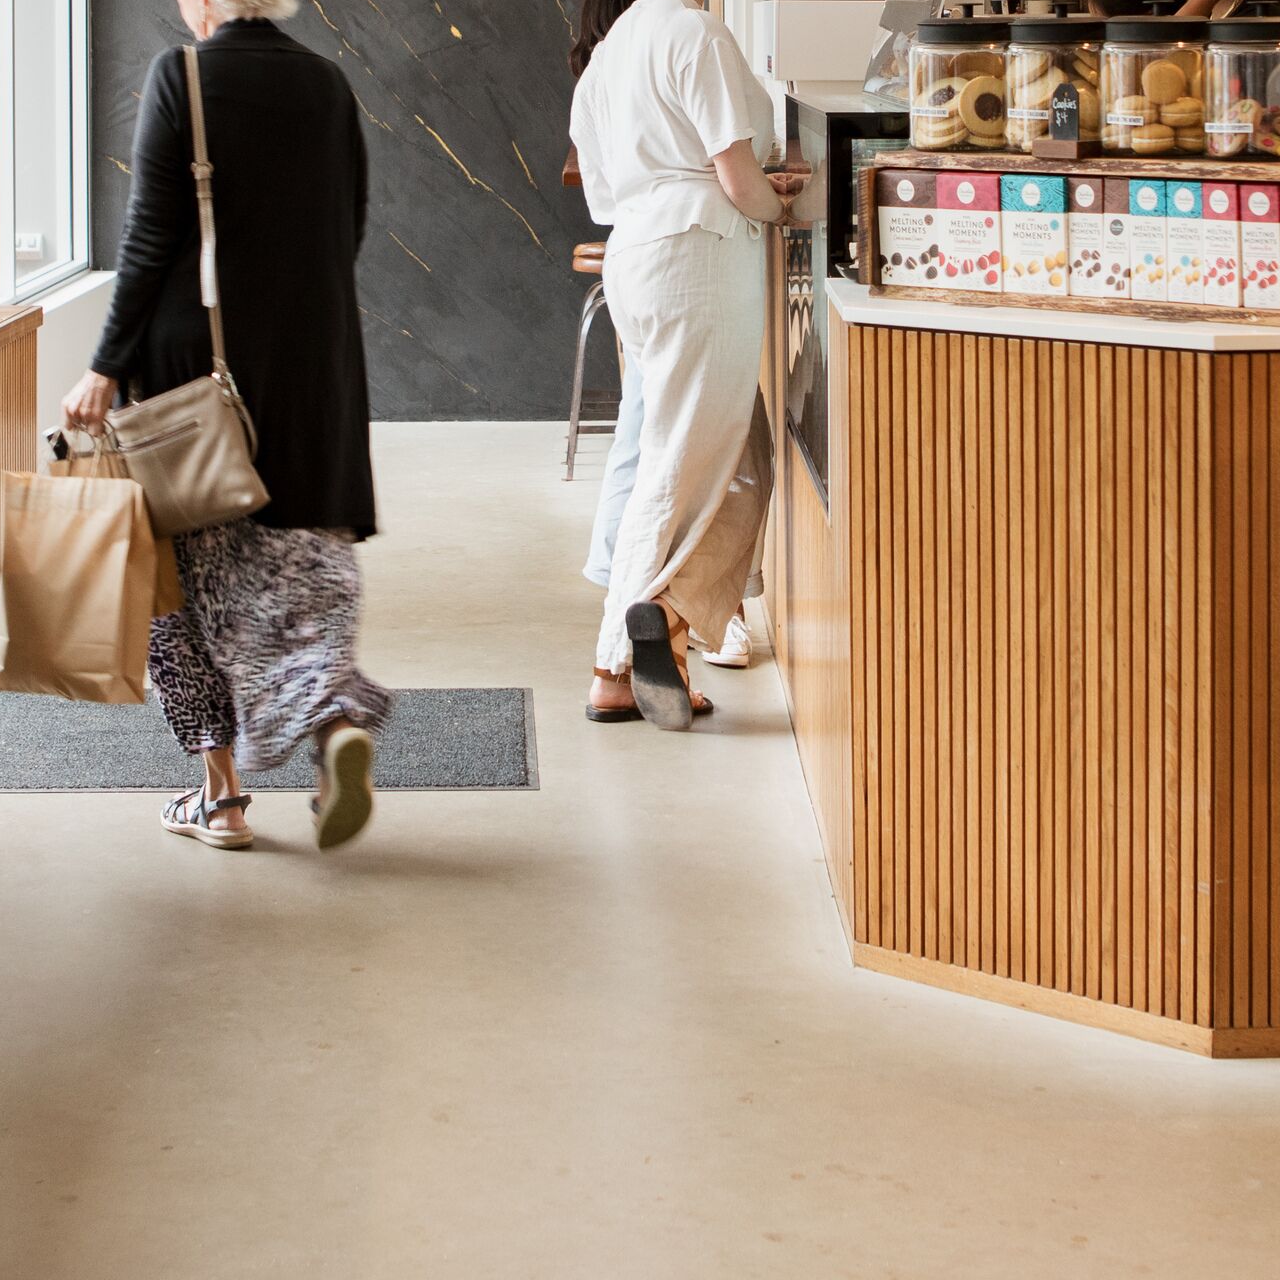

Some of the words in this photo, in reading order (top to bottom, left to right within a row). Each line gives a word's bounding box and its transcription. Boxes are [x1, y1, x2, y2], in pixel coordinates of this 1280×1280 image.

[1052, 97, 1077, 110] Cookies
[1056, 111, 1068, 127] $4
[891, 217, 924, 226] MELTING
[950, 220, 984, 228] MELTING
[889, 226, 927, 234] MOMENTS
[1015, 223, 1049, 231] MELTING
[948, 228, 987, 237] MOMENTS
[1013, 231, 1052, 240] MOMENTS
